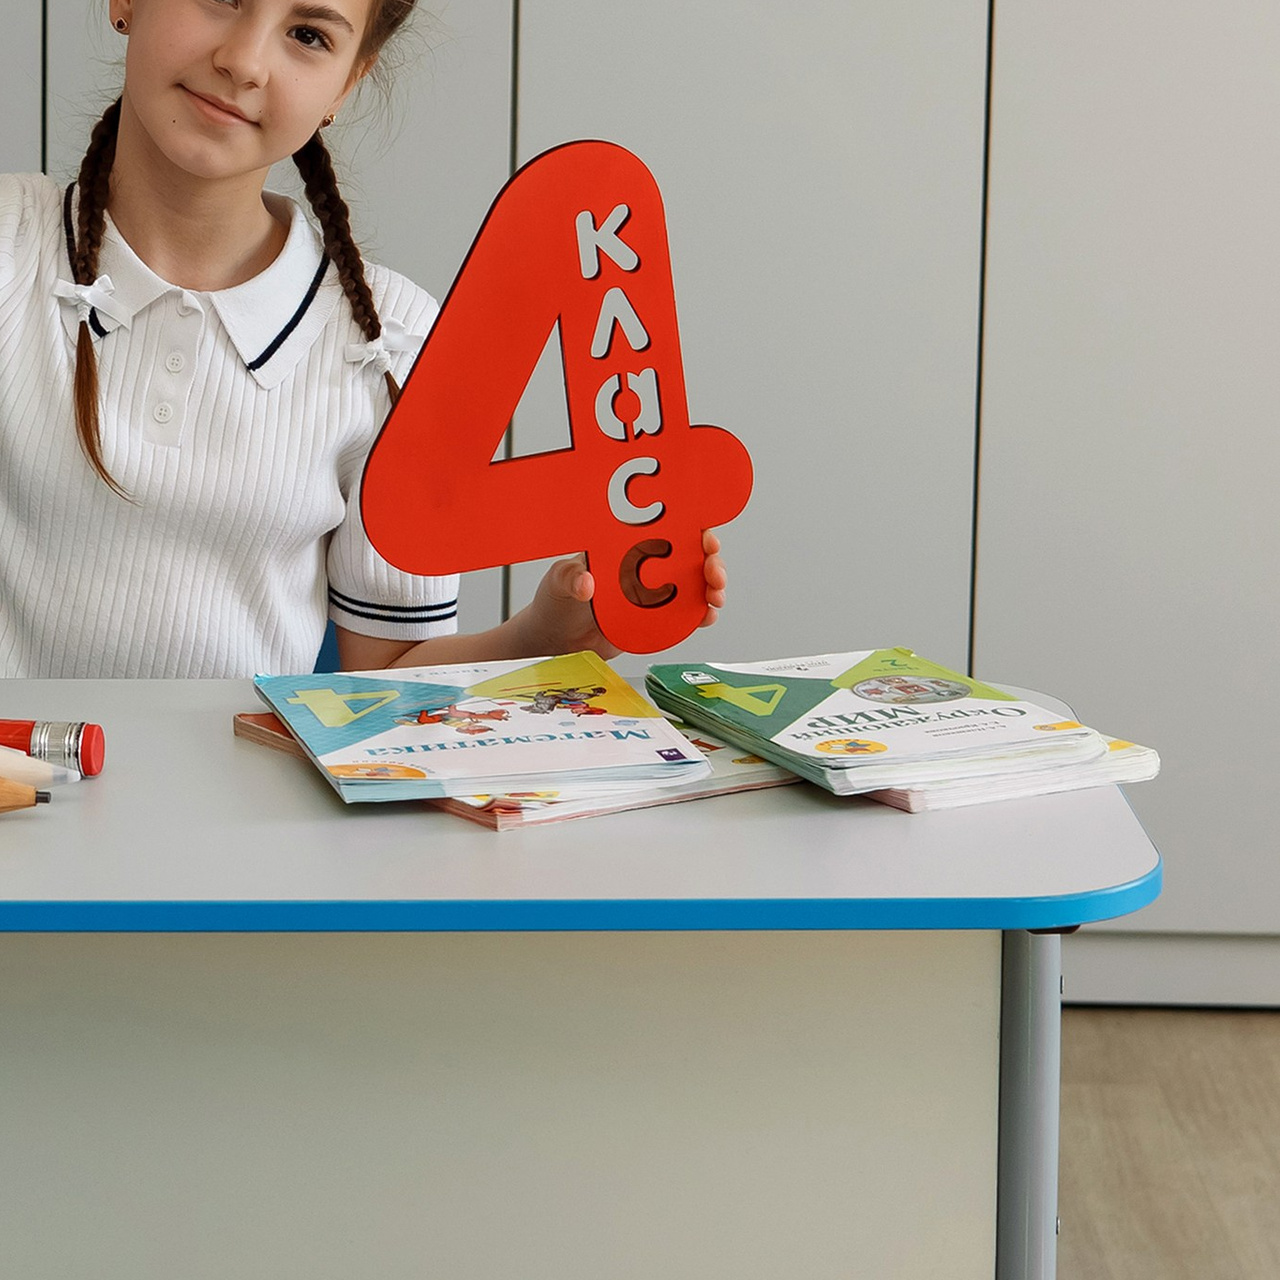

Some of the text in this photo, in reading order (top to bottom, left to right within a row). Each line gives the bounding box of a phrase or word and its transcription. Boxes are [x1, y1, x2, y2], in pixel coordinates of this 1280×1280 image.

[359, 139, 754, 655] 4
[285, 687, 401, 728] 4
[697, 682, 788, 717] 4
[791, 706, 1028, 742] Окружающий
[365, 728, 654, 757] Математика
